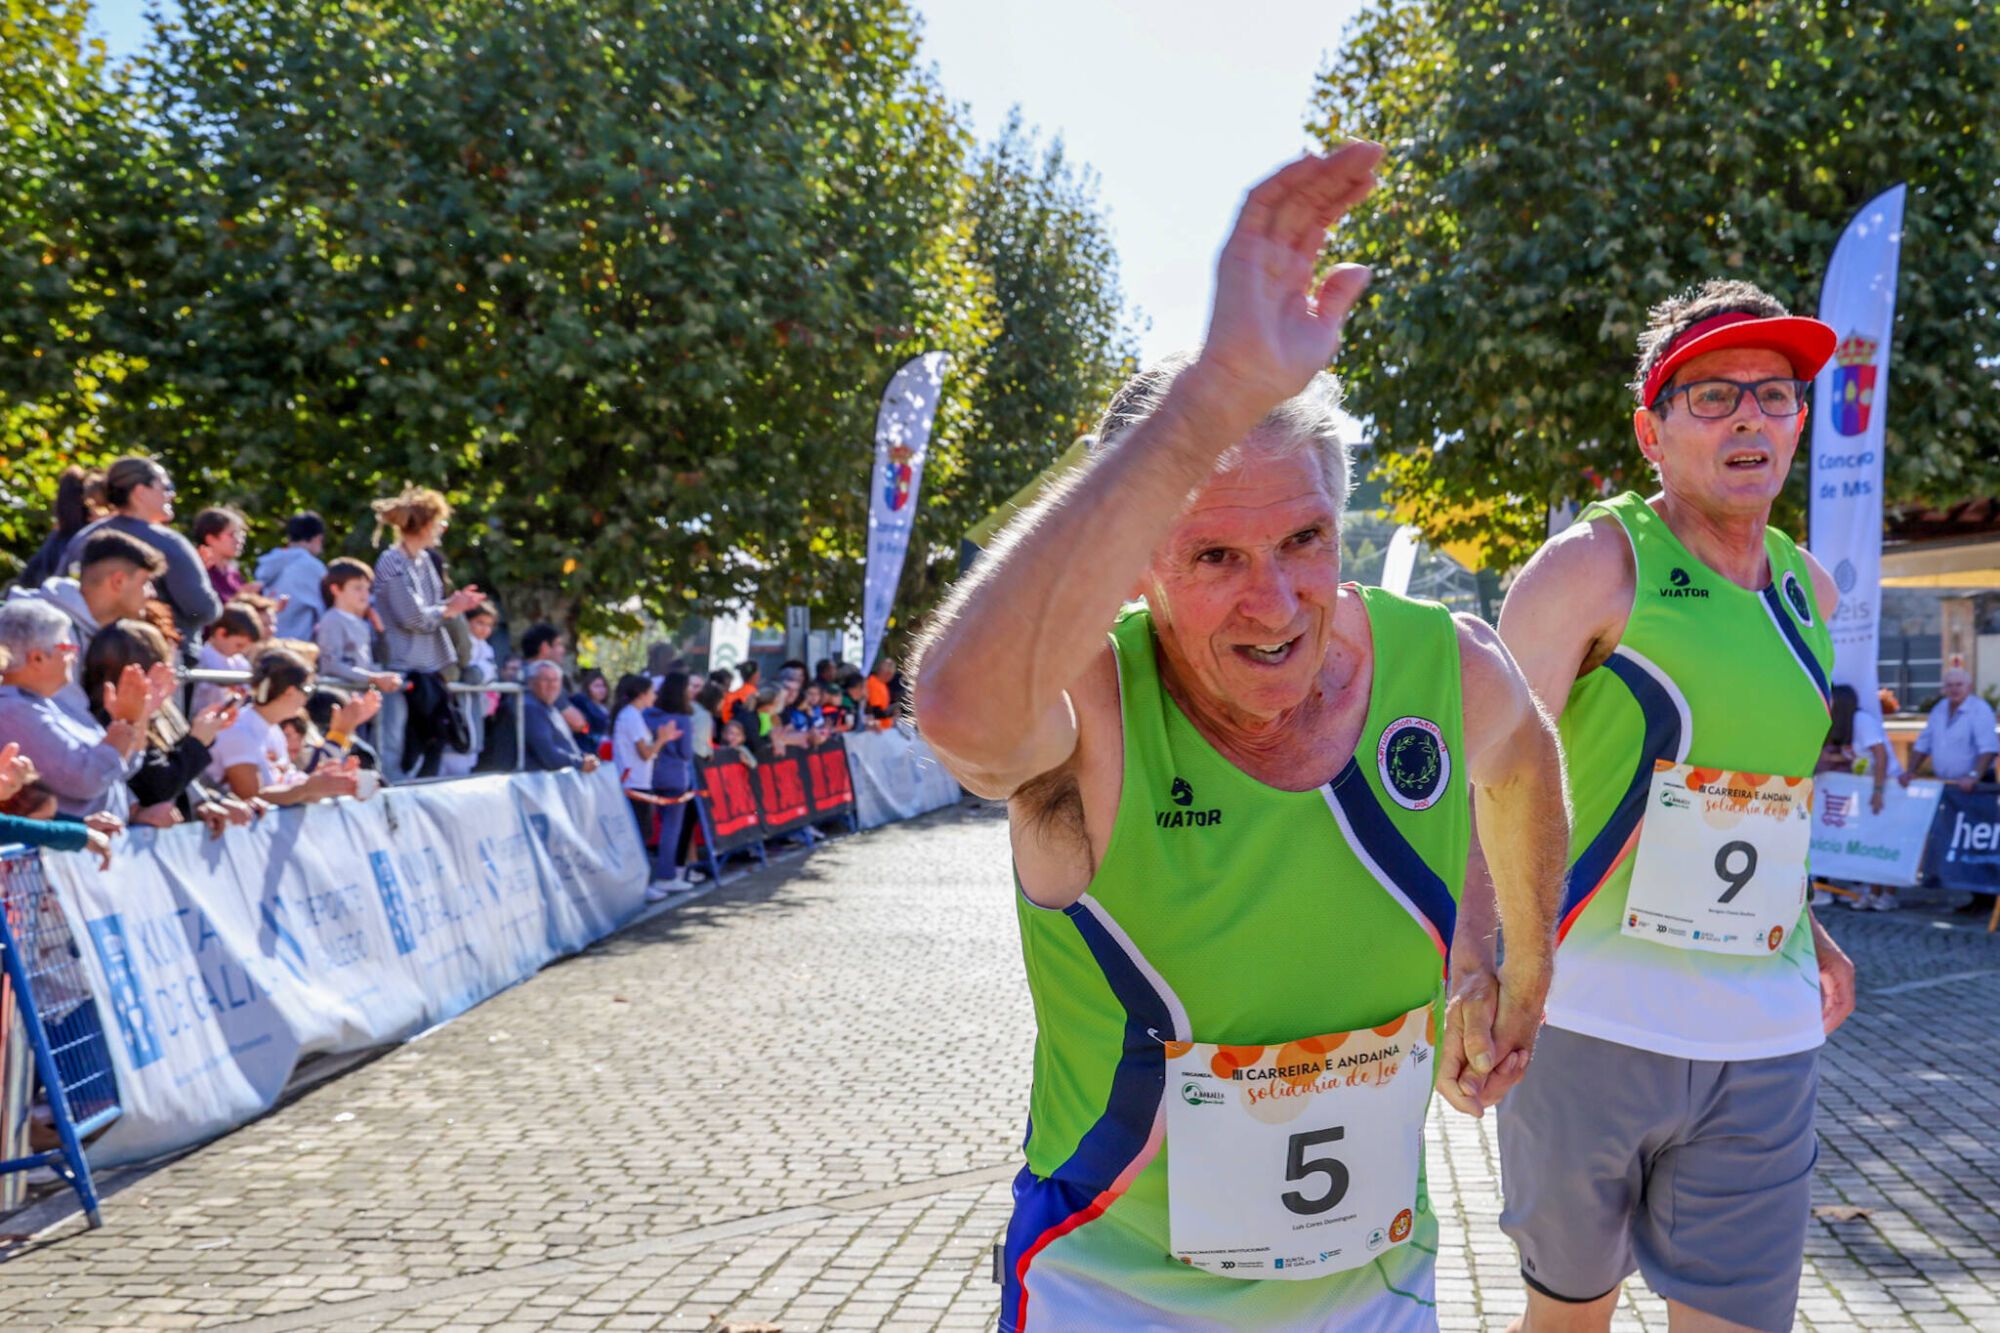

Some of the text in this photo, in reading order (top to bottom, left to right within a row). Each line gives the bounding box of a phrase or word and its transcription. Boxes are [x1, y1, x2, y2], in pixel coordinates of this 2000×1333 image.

[1660, 588, 1709, 598] VIATOR
[1708, 787, 1752, 800] CARREIRA
[1755, 791, 1760, 800] E
[1156, 809, 1222, 828] VIATOR
[1714, 840, 1758, 904] 9
[1232, 1069, 1243, 1081] III
[1246, 1062, 1321, 1081] CARREIRA
[1325, 1059, 1333, 1070] E
[1337, 1044, 1400, 1069] ANDAINA
[1247, 1077, 1340, 1105] solidaria
[1345, 1066, 1369, 1087] de
[1376, 1061, 1398, 1086] Leo
[1281, 1125, 1350, 1215] 5
